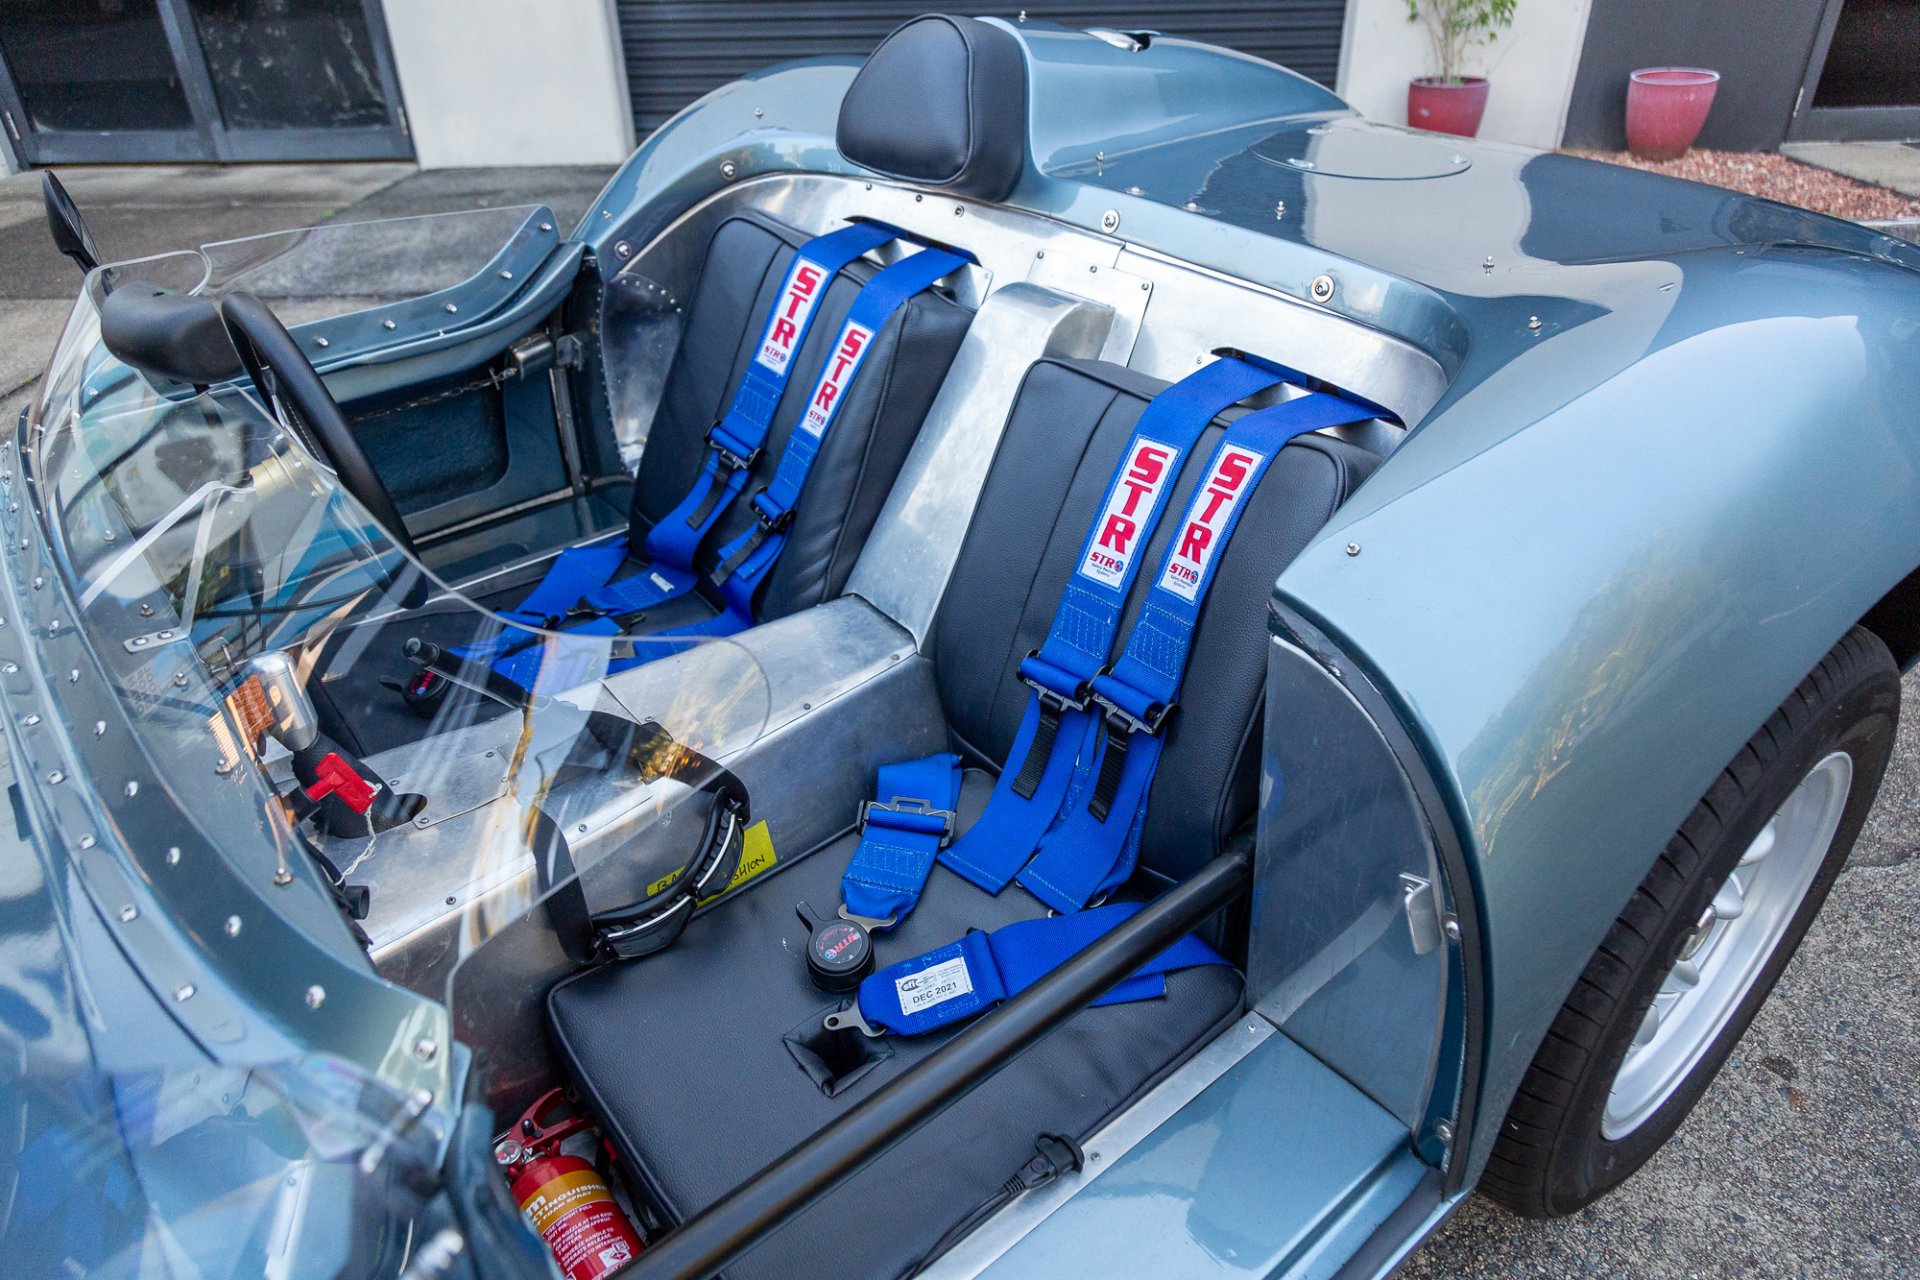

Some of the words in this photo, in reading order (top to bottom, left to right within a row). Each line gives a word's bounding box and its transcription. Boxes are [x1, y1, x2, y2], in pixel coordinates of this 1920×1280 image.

[771, 266, 821, 349] STR
[815, 328, 867, 411] STR
[1098, 446, 1169, 555] STR
[1178, 452, 1254, 564] STR
[912, 990, 933, 1004] DEC
[935, 981, 957, 995] 2021
[543, 1202, 565, 1220] FOAM
[566, 1191, 592, 1203] SPRAY
[579, 1204, 592, 1212] PULL
